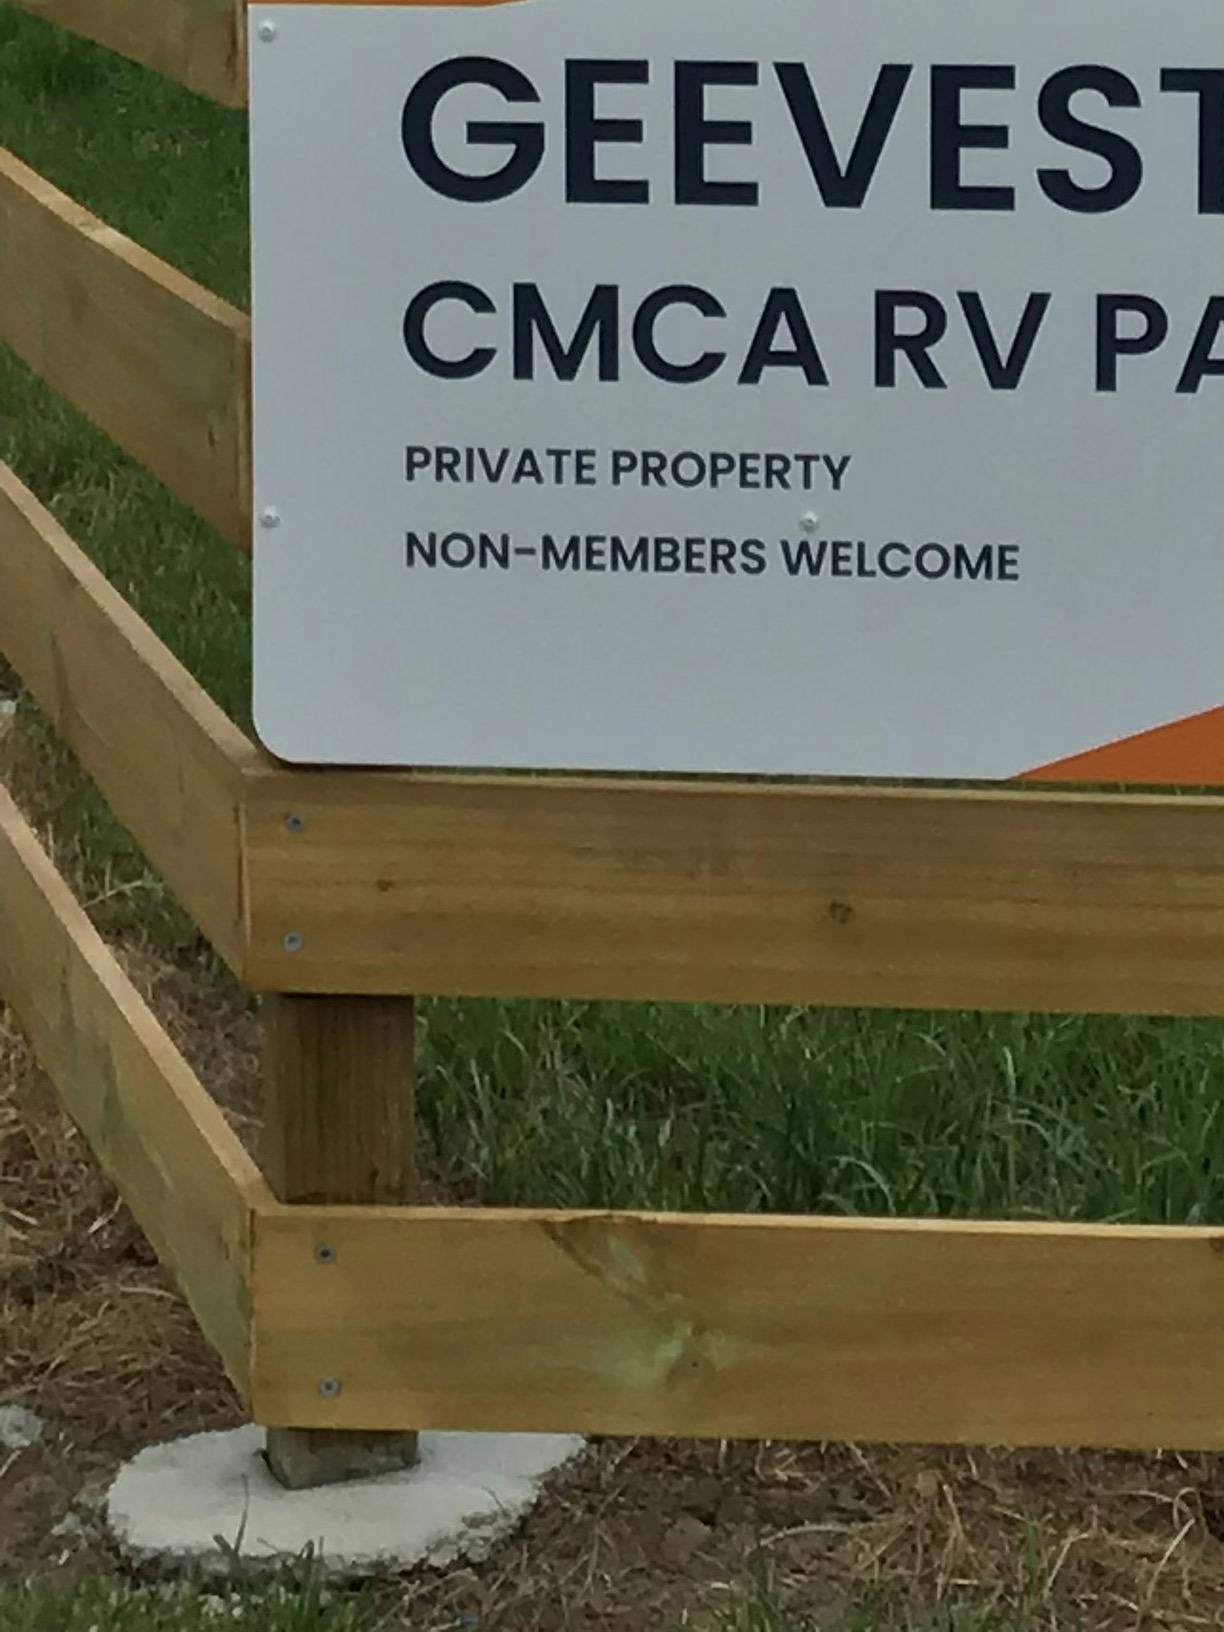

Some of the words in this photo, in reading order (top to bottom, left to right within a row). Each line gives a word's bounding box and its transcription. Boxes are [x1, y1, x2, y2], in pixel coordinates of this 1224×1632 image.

[402, 280, 830, 387] CMCA
[874, 289, 1052, 390] RV
[405, 445, 597, 486] PRIVATE
[611, 449, 852, 491] PROPERTY
[406, 530, 768, 575] NON-MEMBERS
[779, 539, 1020, 581] WELCOME
